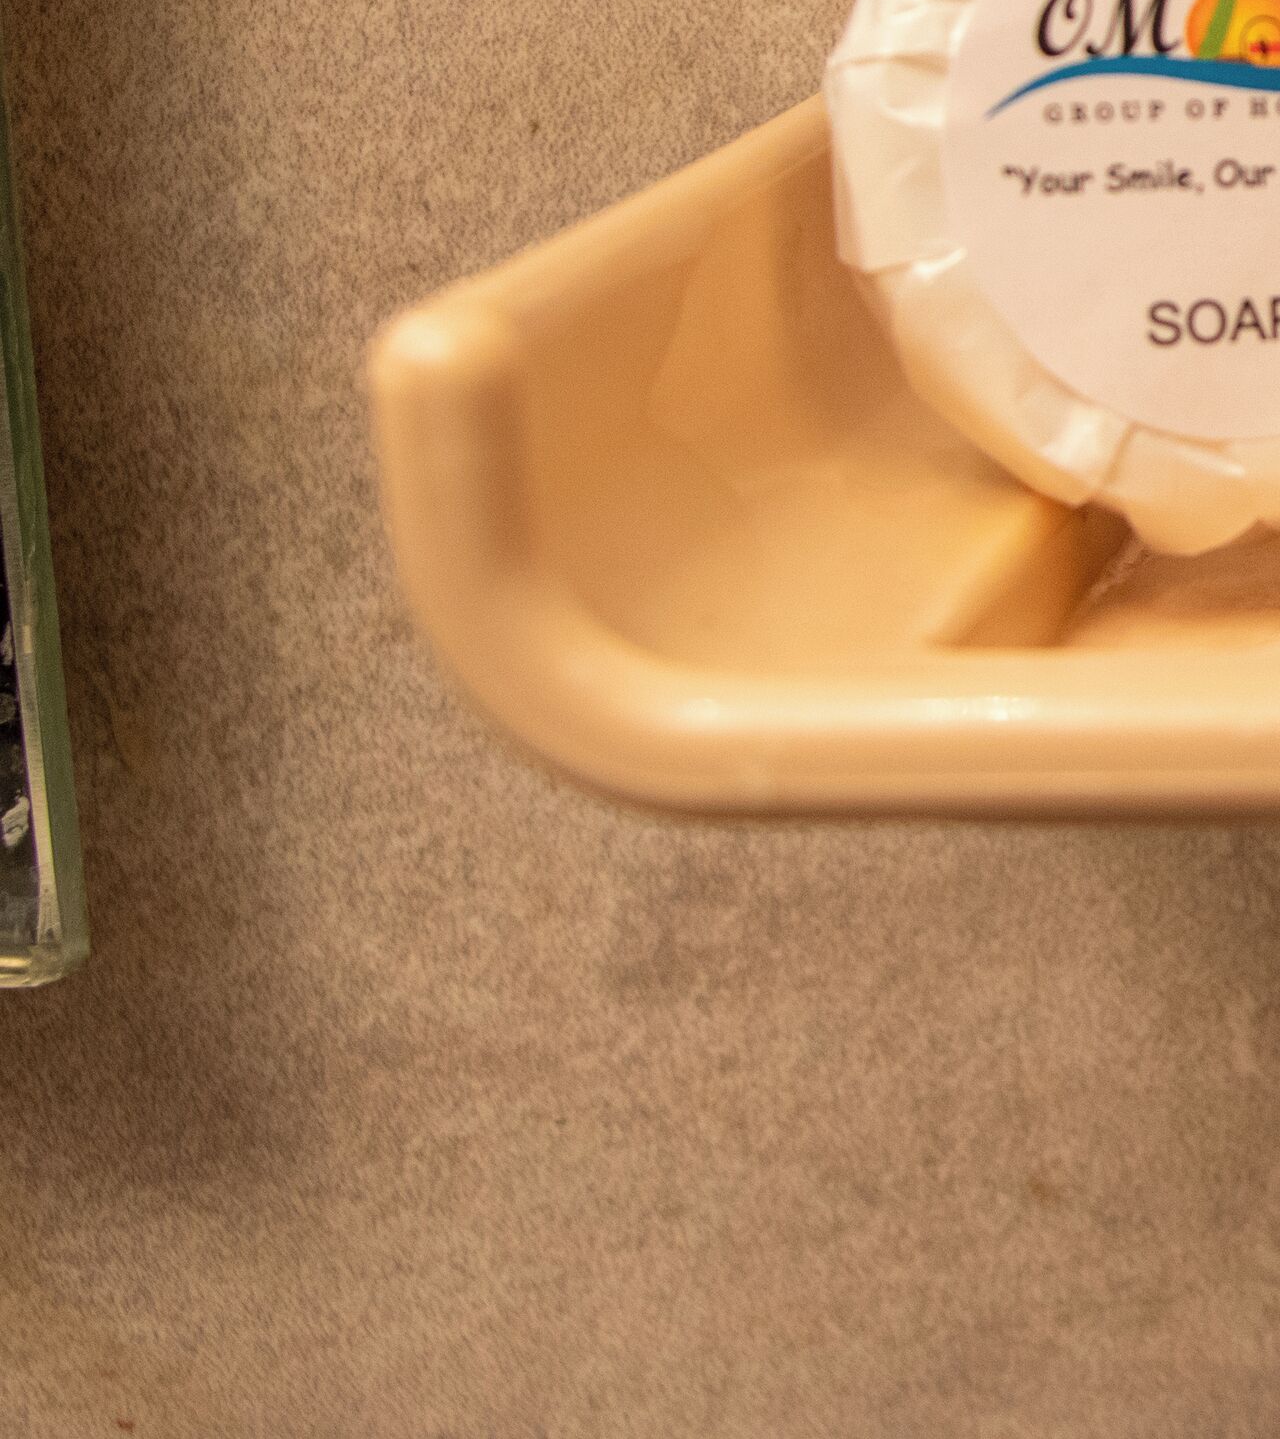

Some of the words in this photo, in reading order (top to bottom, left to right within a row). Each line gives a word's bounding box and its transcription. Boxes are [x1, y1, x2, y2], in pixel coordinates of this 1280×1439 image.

[1044, 100, 1166, 123] GROUP
[1185, 98, 1230, 120] OF
[1105, 160, 1204, 194] Smile,
[1214, 158, 1276, 189] Our
